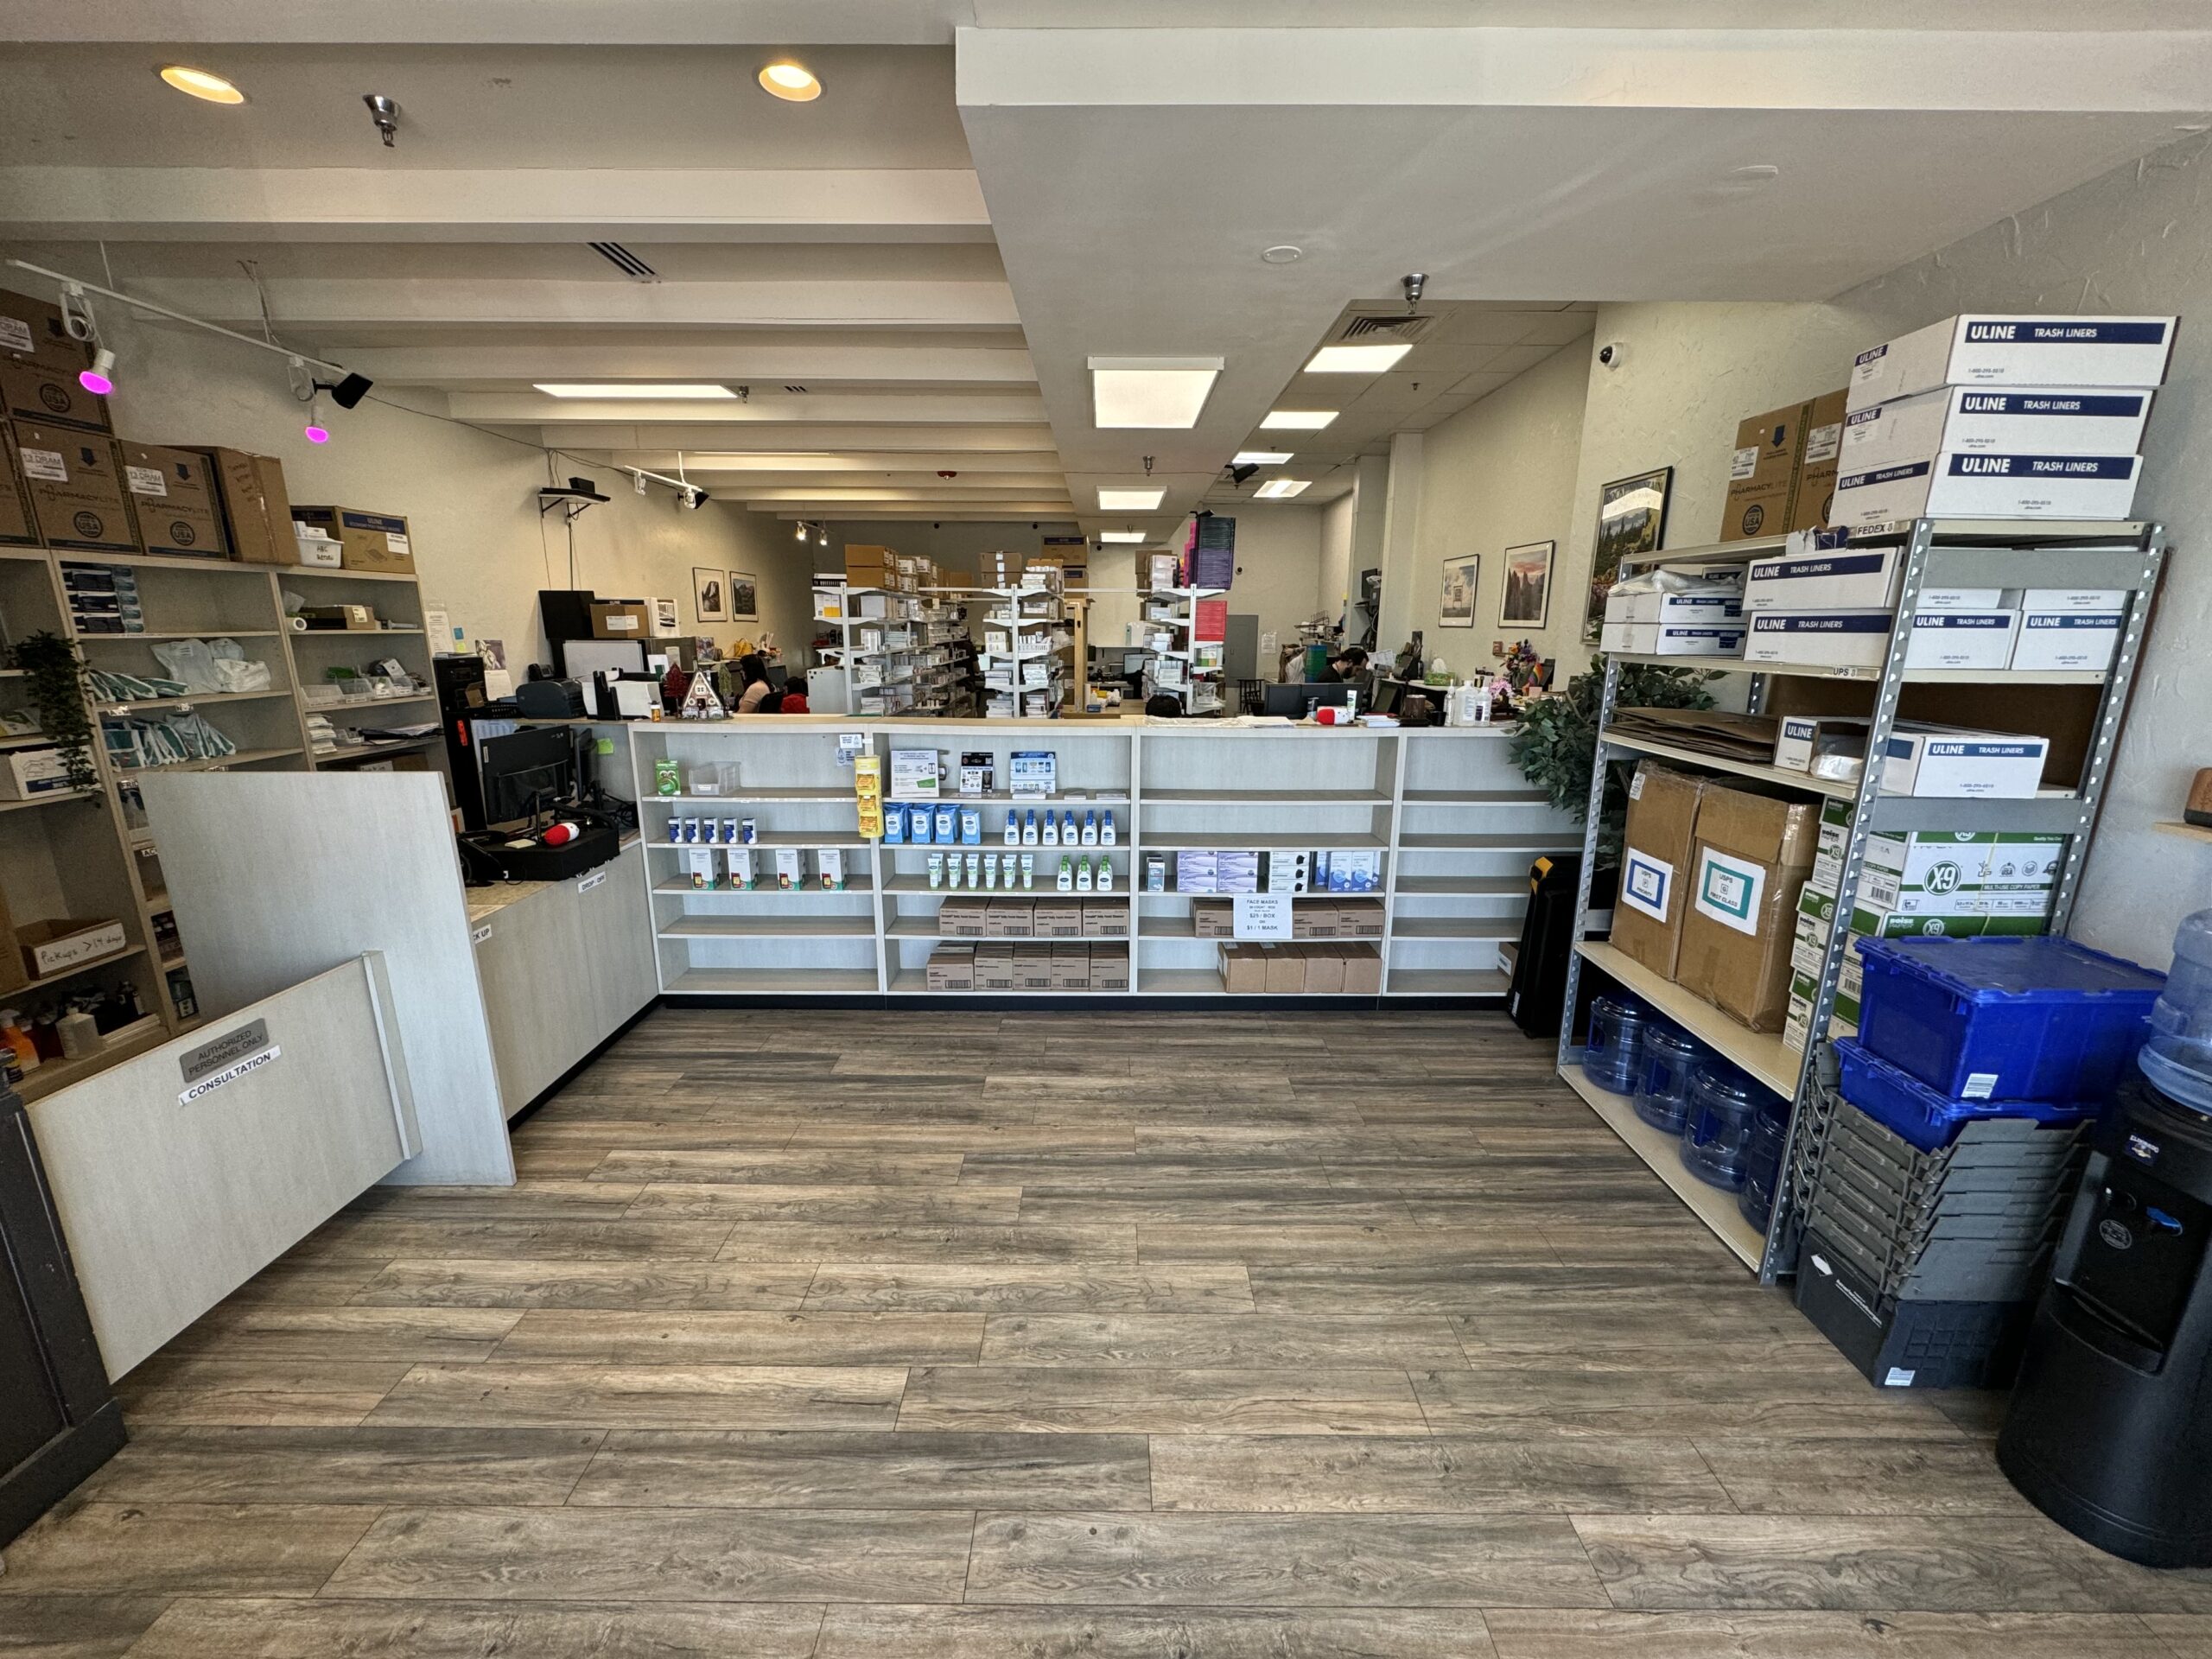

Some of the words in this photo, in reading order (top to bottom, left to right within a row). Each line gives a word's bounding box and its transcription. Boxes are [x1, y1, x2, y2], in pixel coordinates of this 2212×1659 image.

[1970, 325, 2016, 340] ULINE
[2034, 328, 2064, 337] TRASH
[2065, 328, 2097, 338] LINERS
[1859, 346, 1884, 363] ULINE
[1965, 397, 2006, 410] ULINE
[2024, 401, 2050, 410] TRASH
[2052, 401, 2081, 410] LINERS
[1851, 410, 1877, 424] ULINE
[1961, 457, 2011, 473] ULINE
[2032, 461, 2063, 471] TRASH
[2065, 461, 2099, 472] LINERS
[1841, 475, 1866, 487] ULINE
[1893, 467, 1914, 477] LINERS
[1858, 524, 1885, 534] FEDEX
[1754, 566, 1780, 578] ULINE
[1809, 564, 1832, 573] LINERS
[1757, 620, 1786, 630] ULINE
[1916, 617, 1945, 626] ULINE
[2030, 617, 2061, 626] ULINE
[1788, 725, 1812, 738] ULINE
[1932, 745, 1965, 754] ULINE
[1641, 870, 1651, 879] USPS
[1719, 874, 1733, 884] USPS
[582, 880, 594, 891] DROP
[1637, 887, 1653, 897] PRIORITY
[1710, 892, 1722, 902] FIRST
[1722, 897, 1738, 907] CLASS
[480, 929, 490, 938] UP
[198, 1030, 251, 1060] AUTHORIZED
[188, 1047, 241, 1073] PERSONNEL
[242, 1034, 264, 1049] ONLY
[188, 1052, 270, 1099] CONSULTATION
